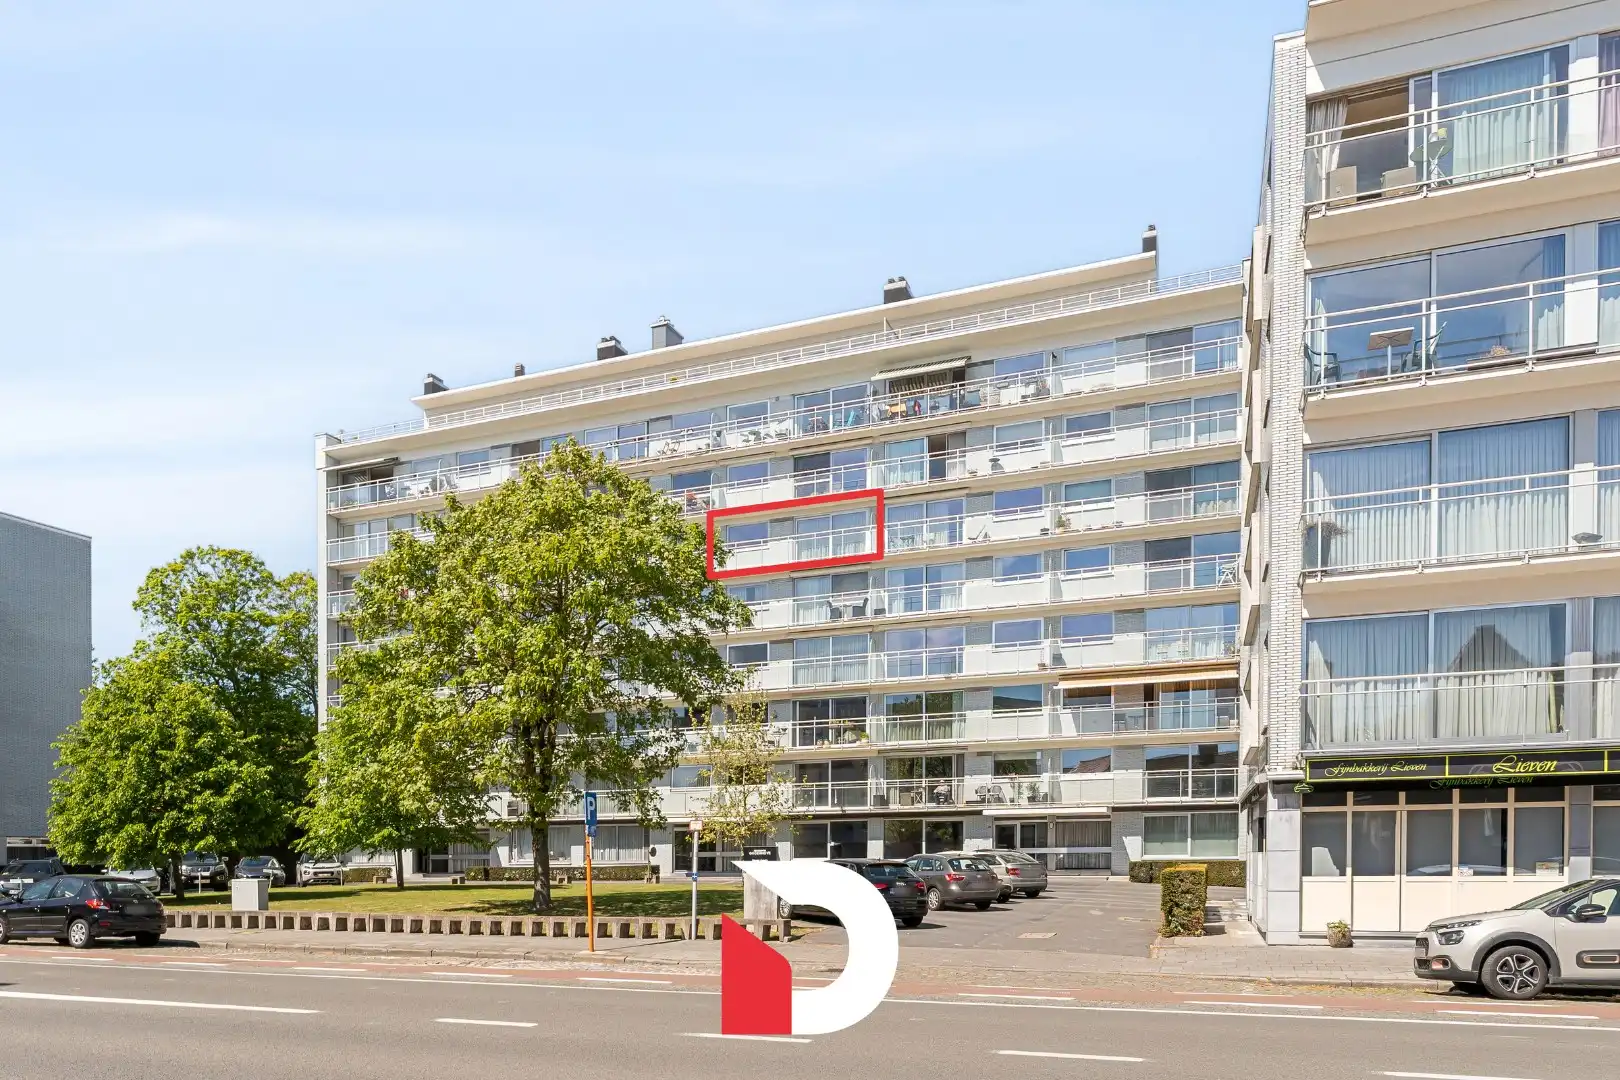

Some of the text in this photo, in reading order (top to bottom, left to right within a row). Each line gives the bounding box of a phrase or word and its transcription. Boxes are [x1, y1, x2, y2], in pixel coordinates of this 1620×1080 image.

[1325, 761, 1427, 776] Fijnbakkerij Lieven
[1492, 755, 1558, 773] Lieven
[587, 797, 596, 820] P
